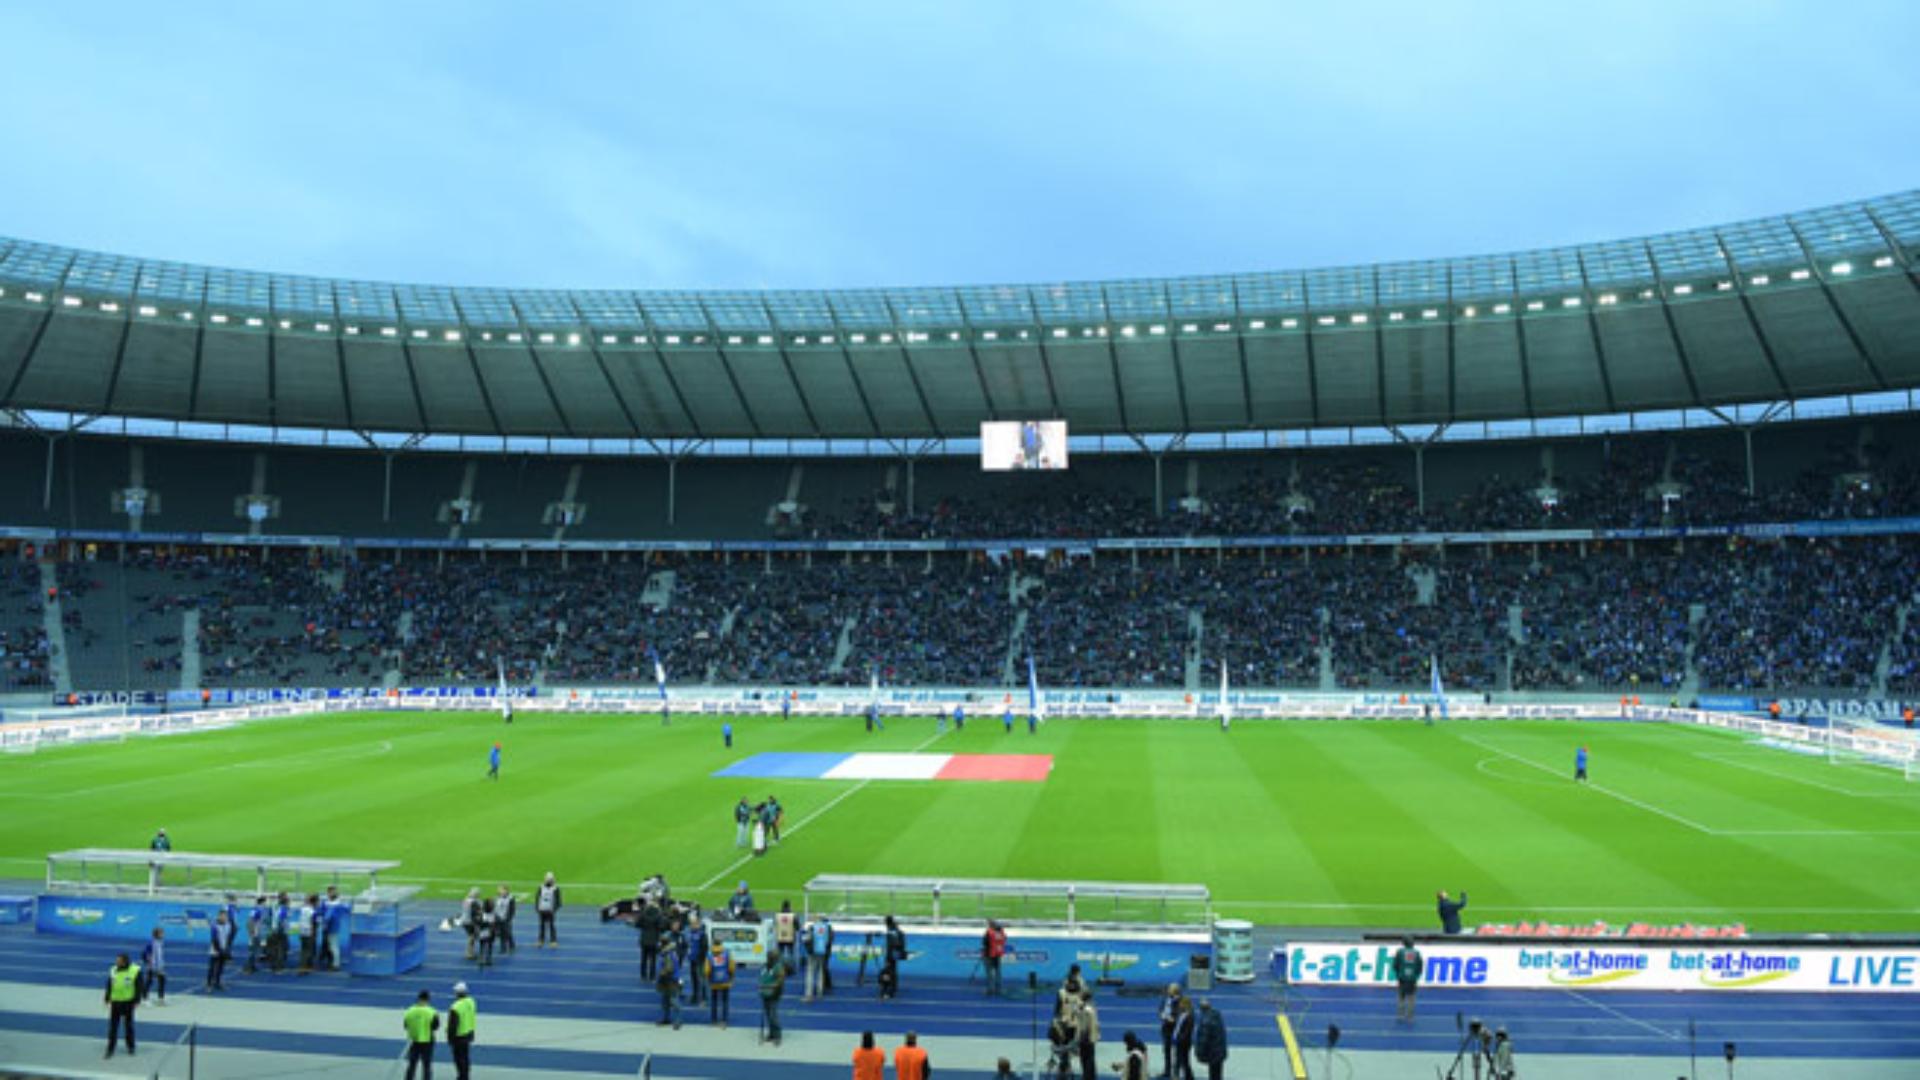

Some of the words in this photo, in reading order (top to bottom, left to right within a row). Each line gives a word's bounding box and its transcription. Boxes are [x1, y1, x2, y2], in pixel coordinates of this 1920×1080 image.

[1290, 946, 1488, 983] t-at-hme
[1518, 948, 1648, 969] bet-at-home
[1669, 951, 1801, 972] bet-at-home
[1828, 956, 1916, 985] LIVE
